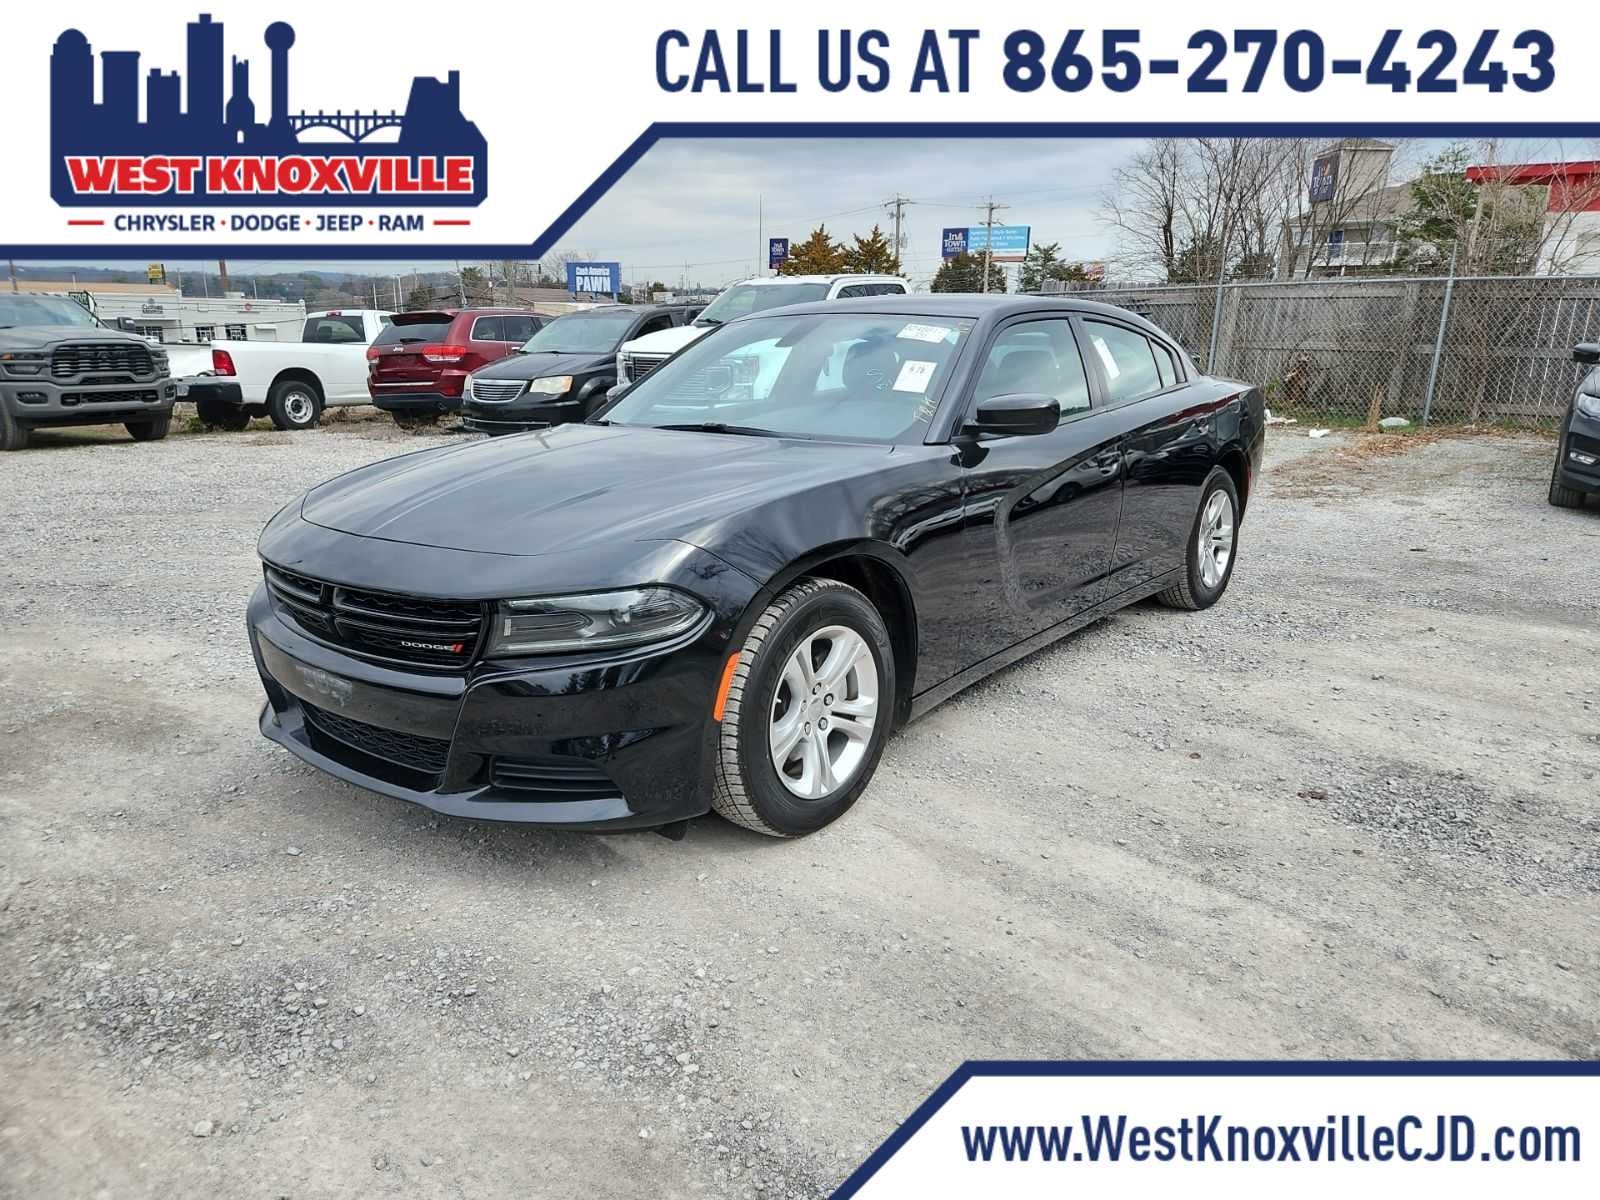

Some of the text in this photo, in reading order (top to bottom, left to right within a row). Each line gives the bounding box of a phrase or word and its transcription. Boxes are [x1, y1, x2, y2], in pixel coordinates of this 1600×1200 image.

[944, 240, 967, 248] Town
[576, 276, 611, 292] PAWN
[401, 641, 456, 652] DODGE
